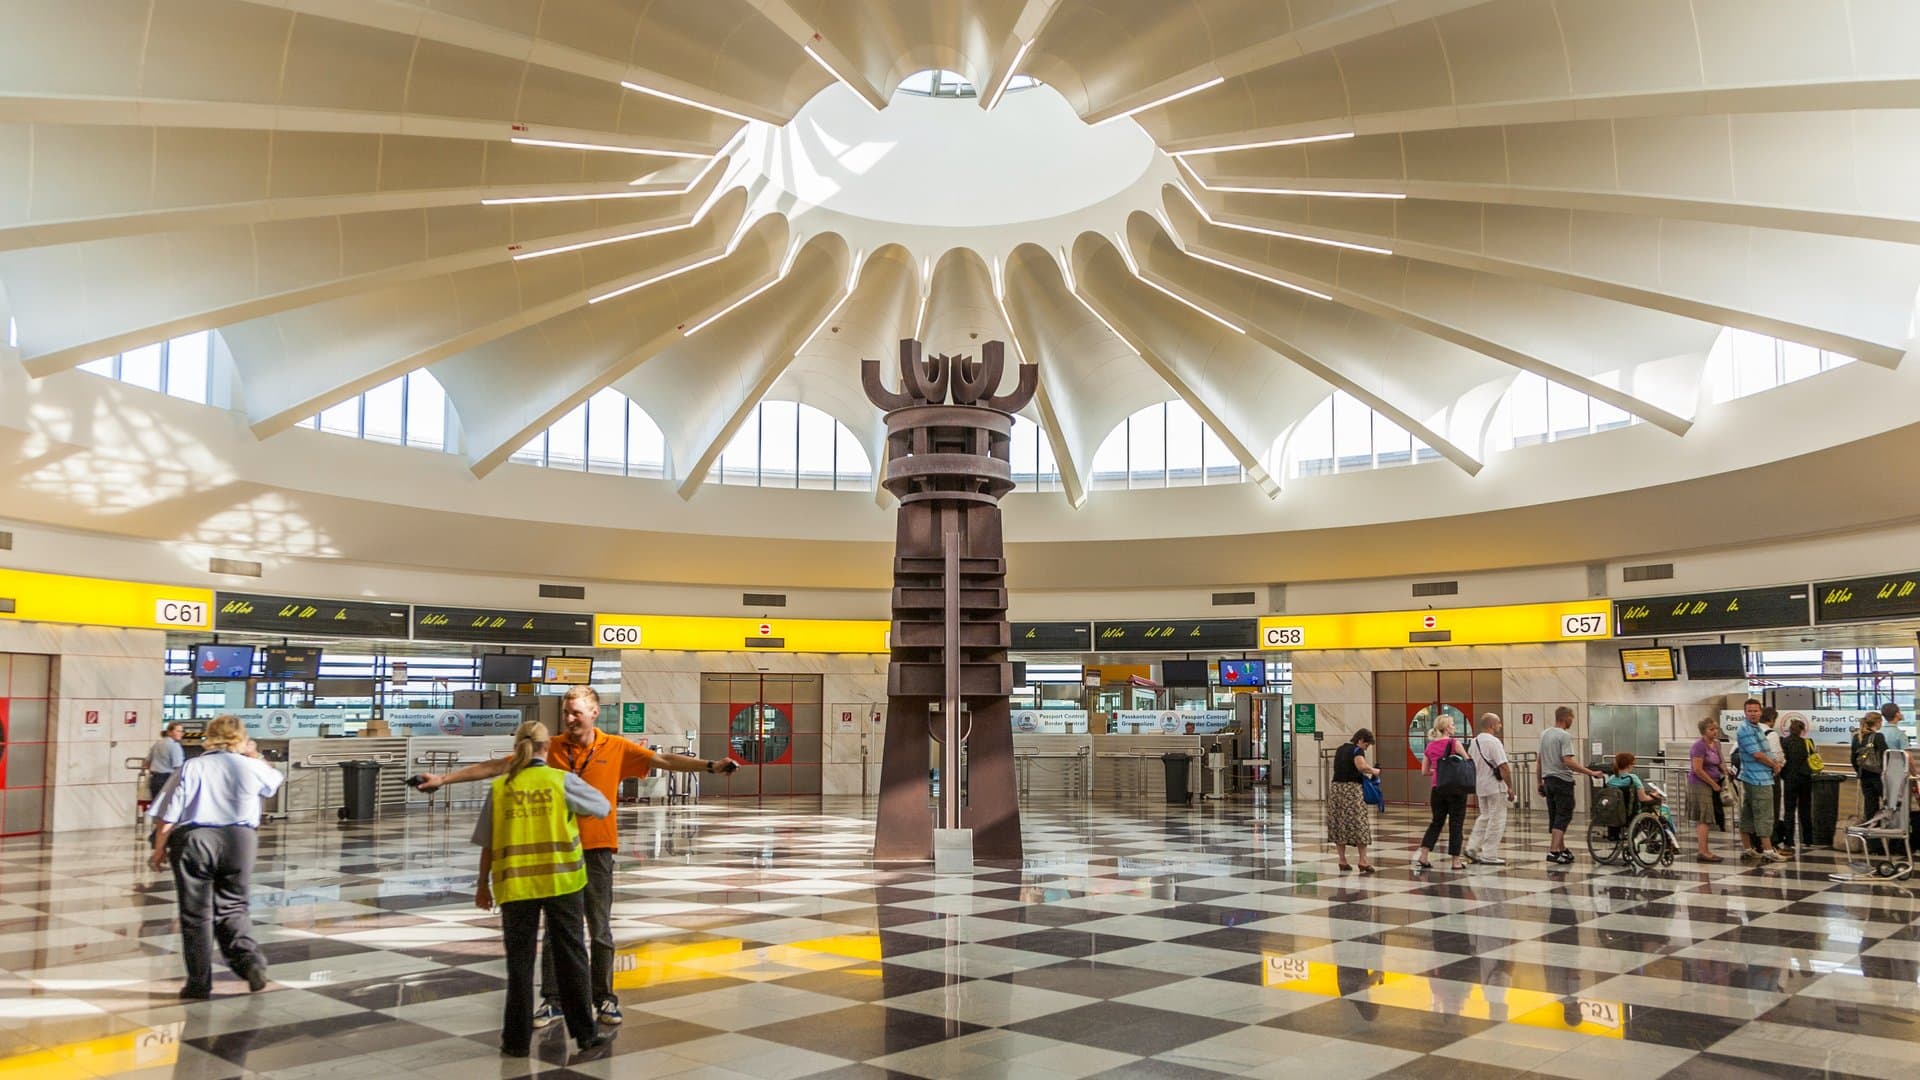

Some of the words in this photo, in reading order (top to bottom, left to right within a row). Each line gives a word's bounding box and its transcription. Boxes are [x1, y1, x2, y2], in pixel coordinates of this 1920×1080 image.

[164, 603, 200, 622] C61
[1566, 616, 1601, 633] C57
[603, 627, 638, 642] C60
[1267, 629, 1301, 644] C58
[292, 713, 320, 722] Passport
[465, 713, 493, 721] Passport
[1181, 713, 1205, 721] Passport
[1811, 715, 1847, 725] Passport
[1818, 725, 1846, 733] Border
